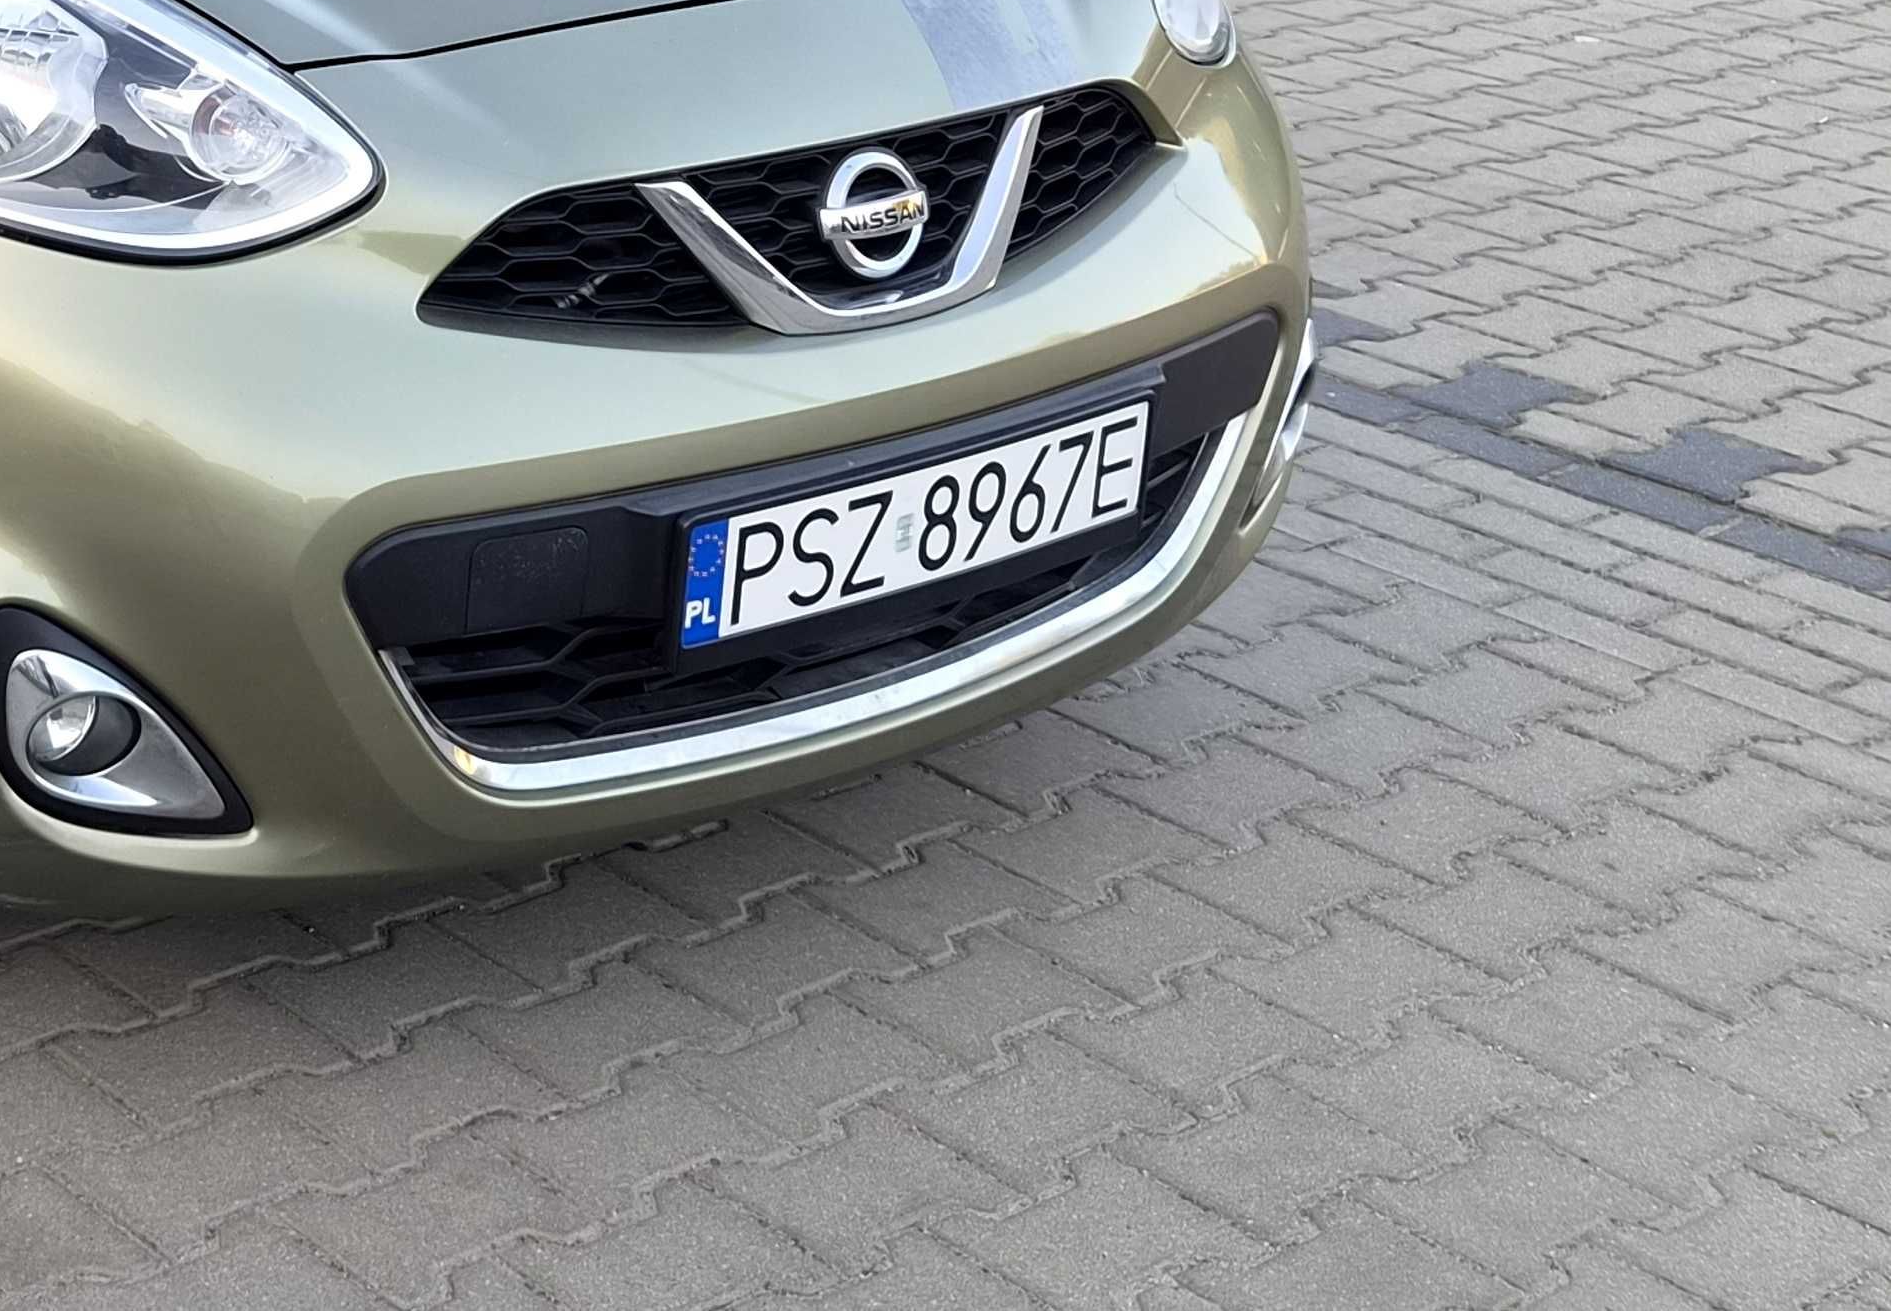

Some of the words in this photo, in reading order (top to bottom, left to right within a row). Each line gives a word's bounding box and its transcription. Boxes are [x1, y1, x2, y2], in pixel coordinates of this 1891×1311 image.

[840, 201, 925, 233] NISSAN
[729, 489, 894, 626] PSZ
[918, 415, 1138, 571] 8967E
[684, 597, 716, 629] PL
